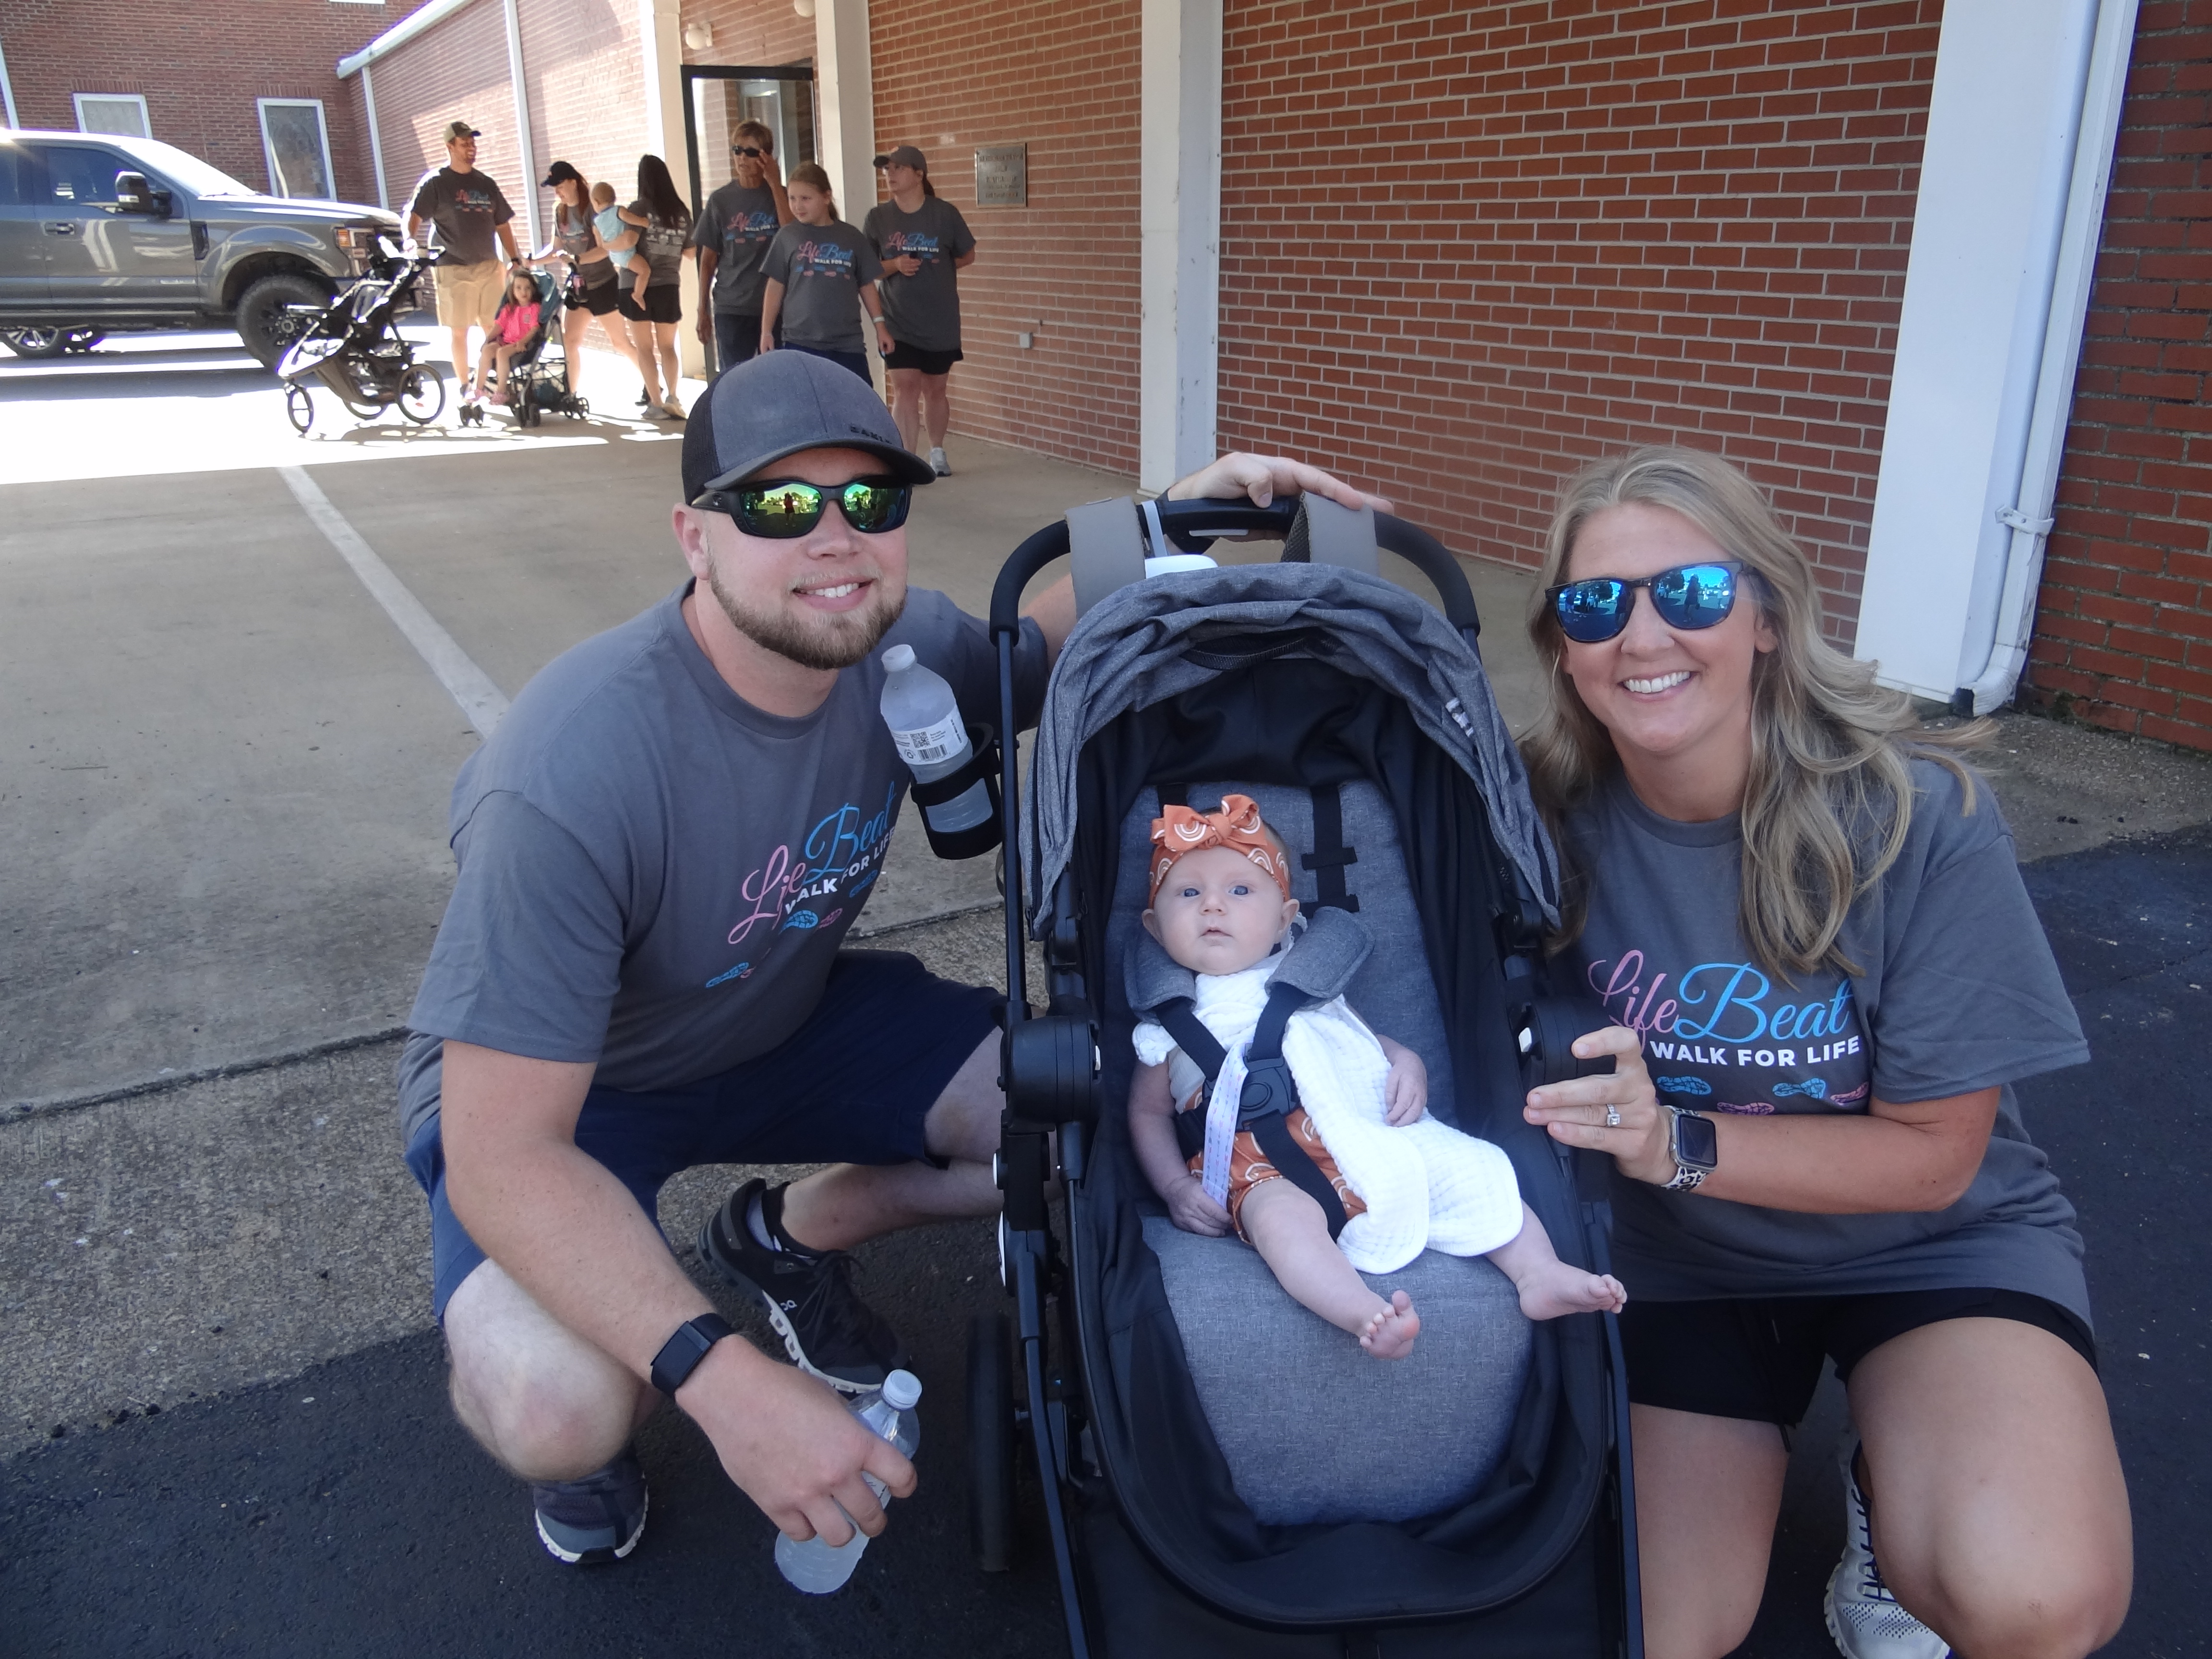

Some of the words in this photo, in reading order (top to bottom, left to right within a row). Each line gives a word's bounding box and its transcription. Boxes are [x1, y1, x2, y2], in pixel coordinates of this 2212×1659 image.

[841, 855, 870, 884] FOR
[1649, 1040, 1728, 1066] WALK
[1737, 1049, 1796, 1067] FOR
[1806, 1035, 1860, 1064] LIFE
